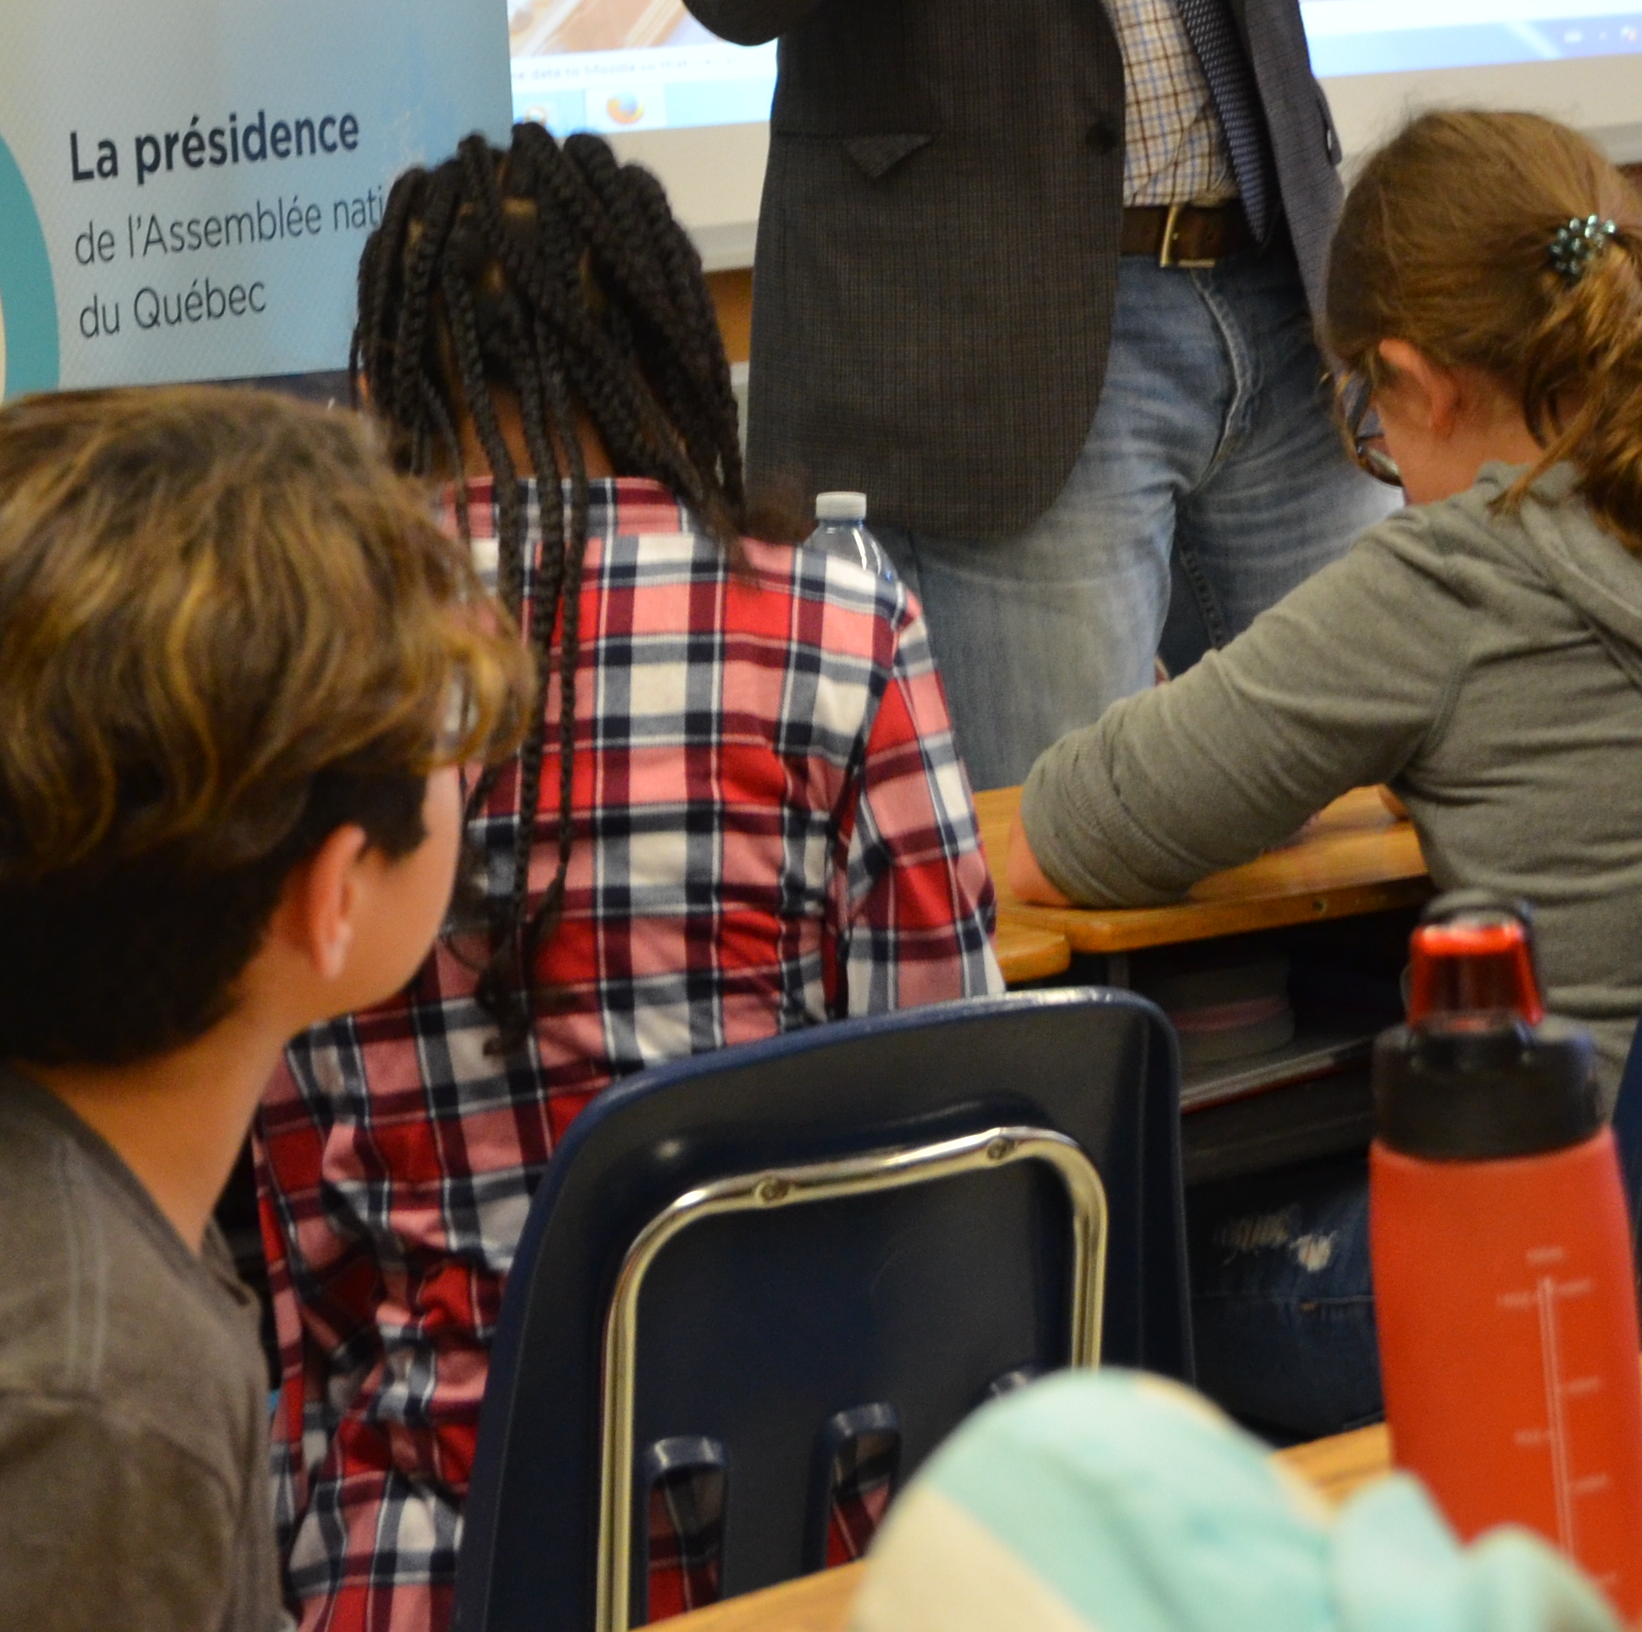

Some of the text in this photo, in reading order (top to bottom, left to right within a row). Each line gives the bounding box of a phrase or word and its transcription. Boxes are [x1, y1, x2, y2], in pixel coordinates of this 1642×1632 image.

[71, 110, 358, 185] La présidence
[75, 185, 385, 265] de l'Assemblée nati
[80, 277, 266, 338] du Québec
